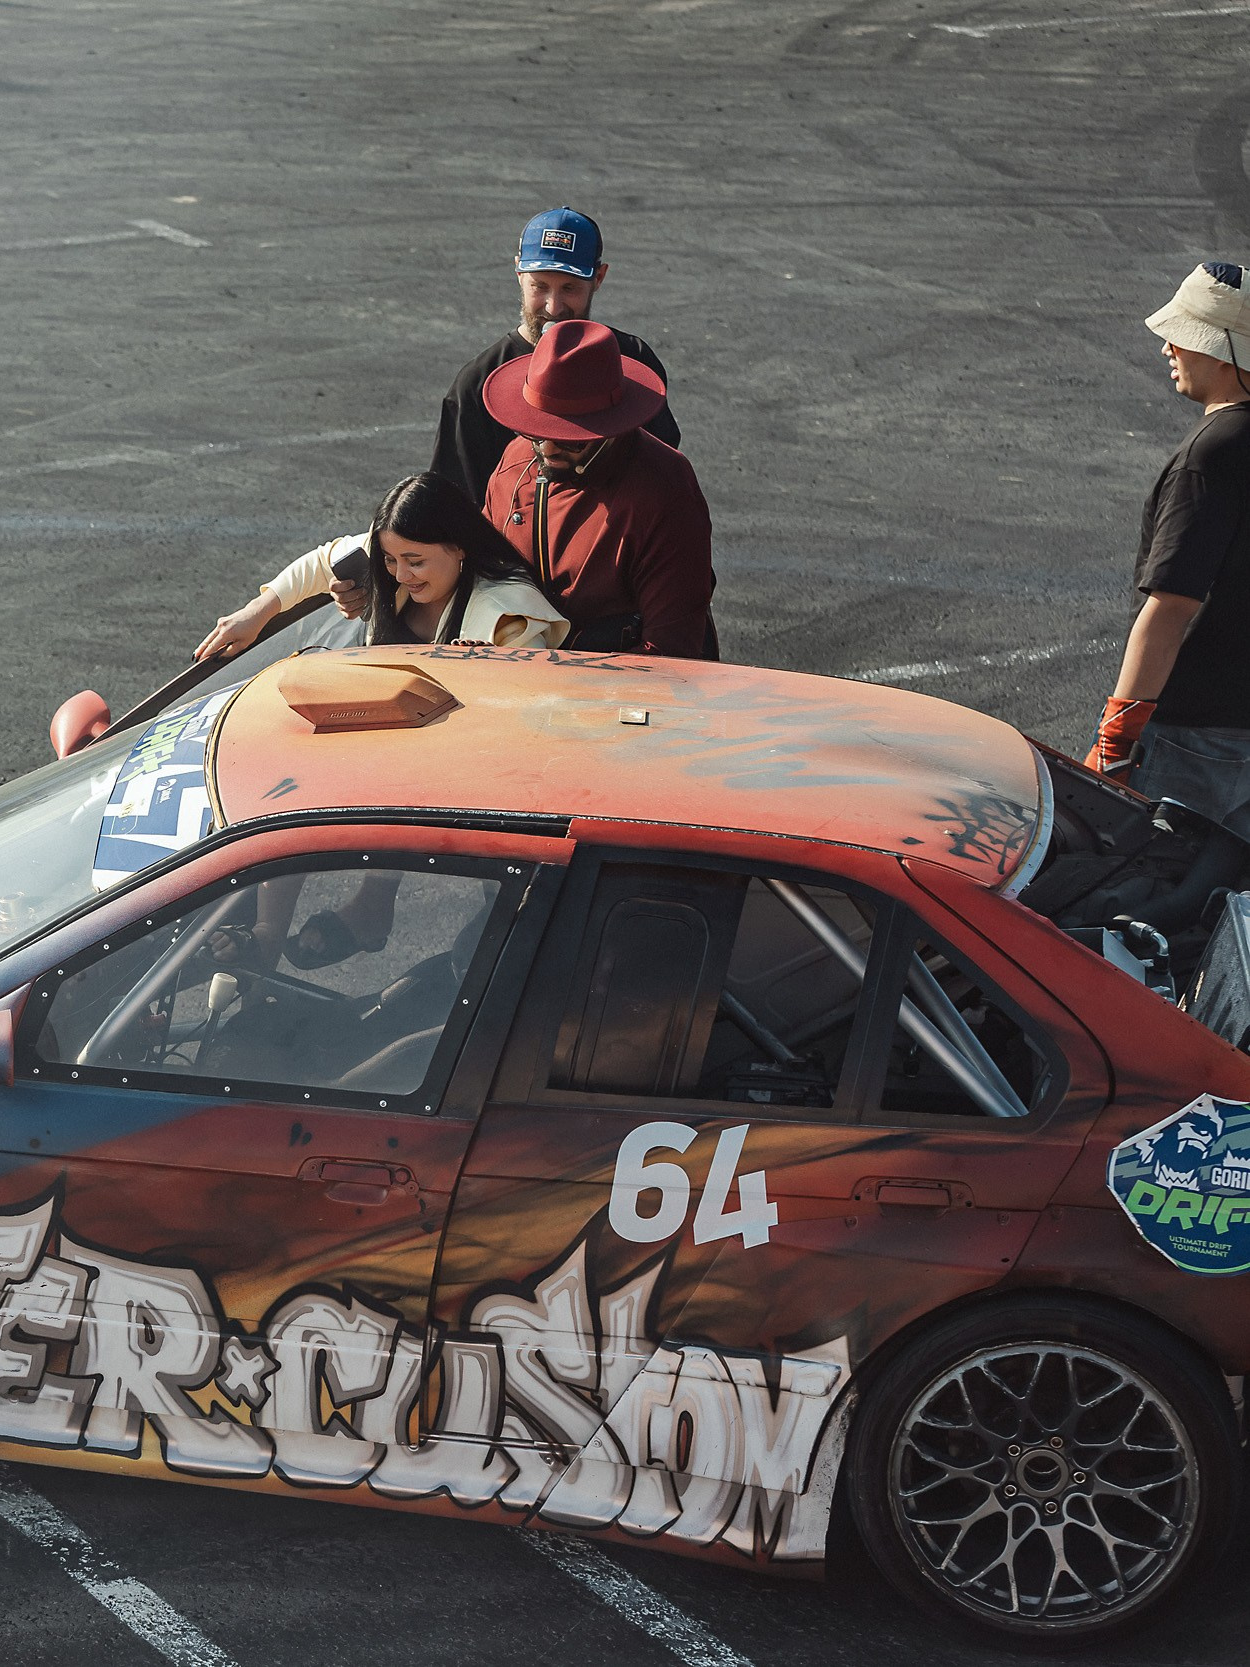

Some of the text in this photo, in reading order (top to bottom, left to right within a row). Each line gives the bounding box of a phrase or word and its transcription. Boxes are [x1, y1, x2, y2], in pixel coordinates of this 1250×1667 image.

[608, 1121, 778, 1250] 64
[1169, 1235, 1233, 1251] ULTIMATE DRIFT
[1173, 1242, 1229, 1258] TOURNAMENT
